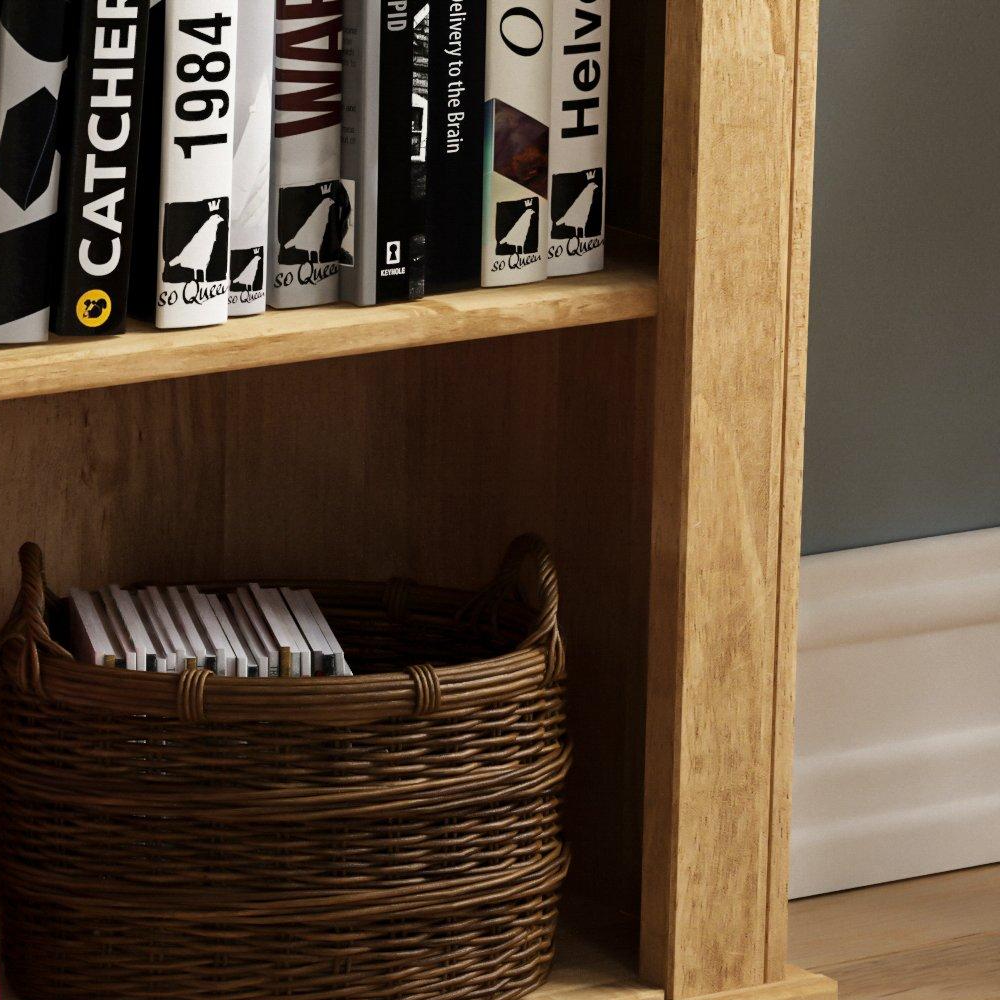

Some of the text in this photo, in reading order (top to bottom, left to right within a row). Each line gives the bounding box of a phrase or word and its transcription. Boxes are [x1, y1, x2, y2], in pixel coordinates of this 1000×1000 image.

[173, 12, 232, 159] 1984
[444, 0, 466, 153] elivery to the Brain
[561, 0, 602, 138] Helv
[298, 260, 340, 285] Quee
